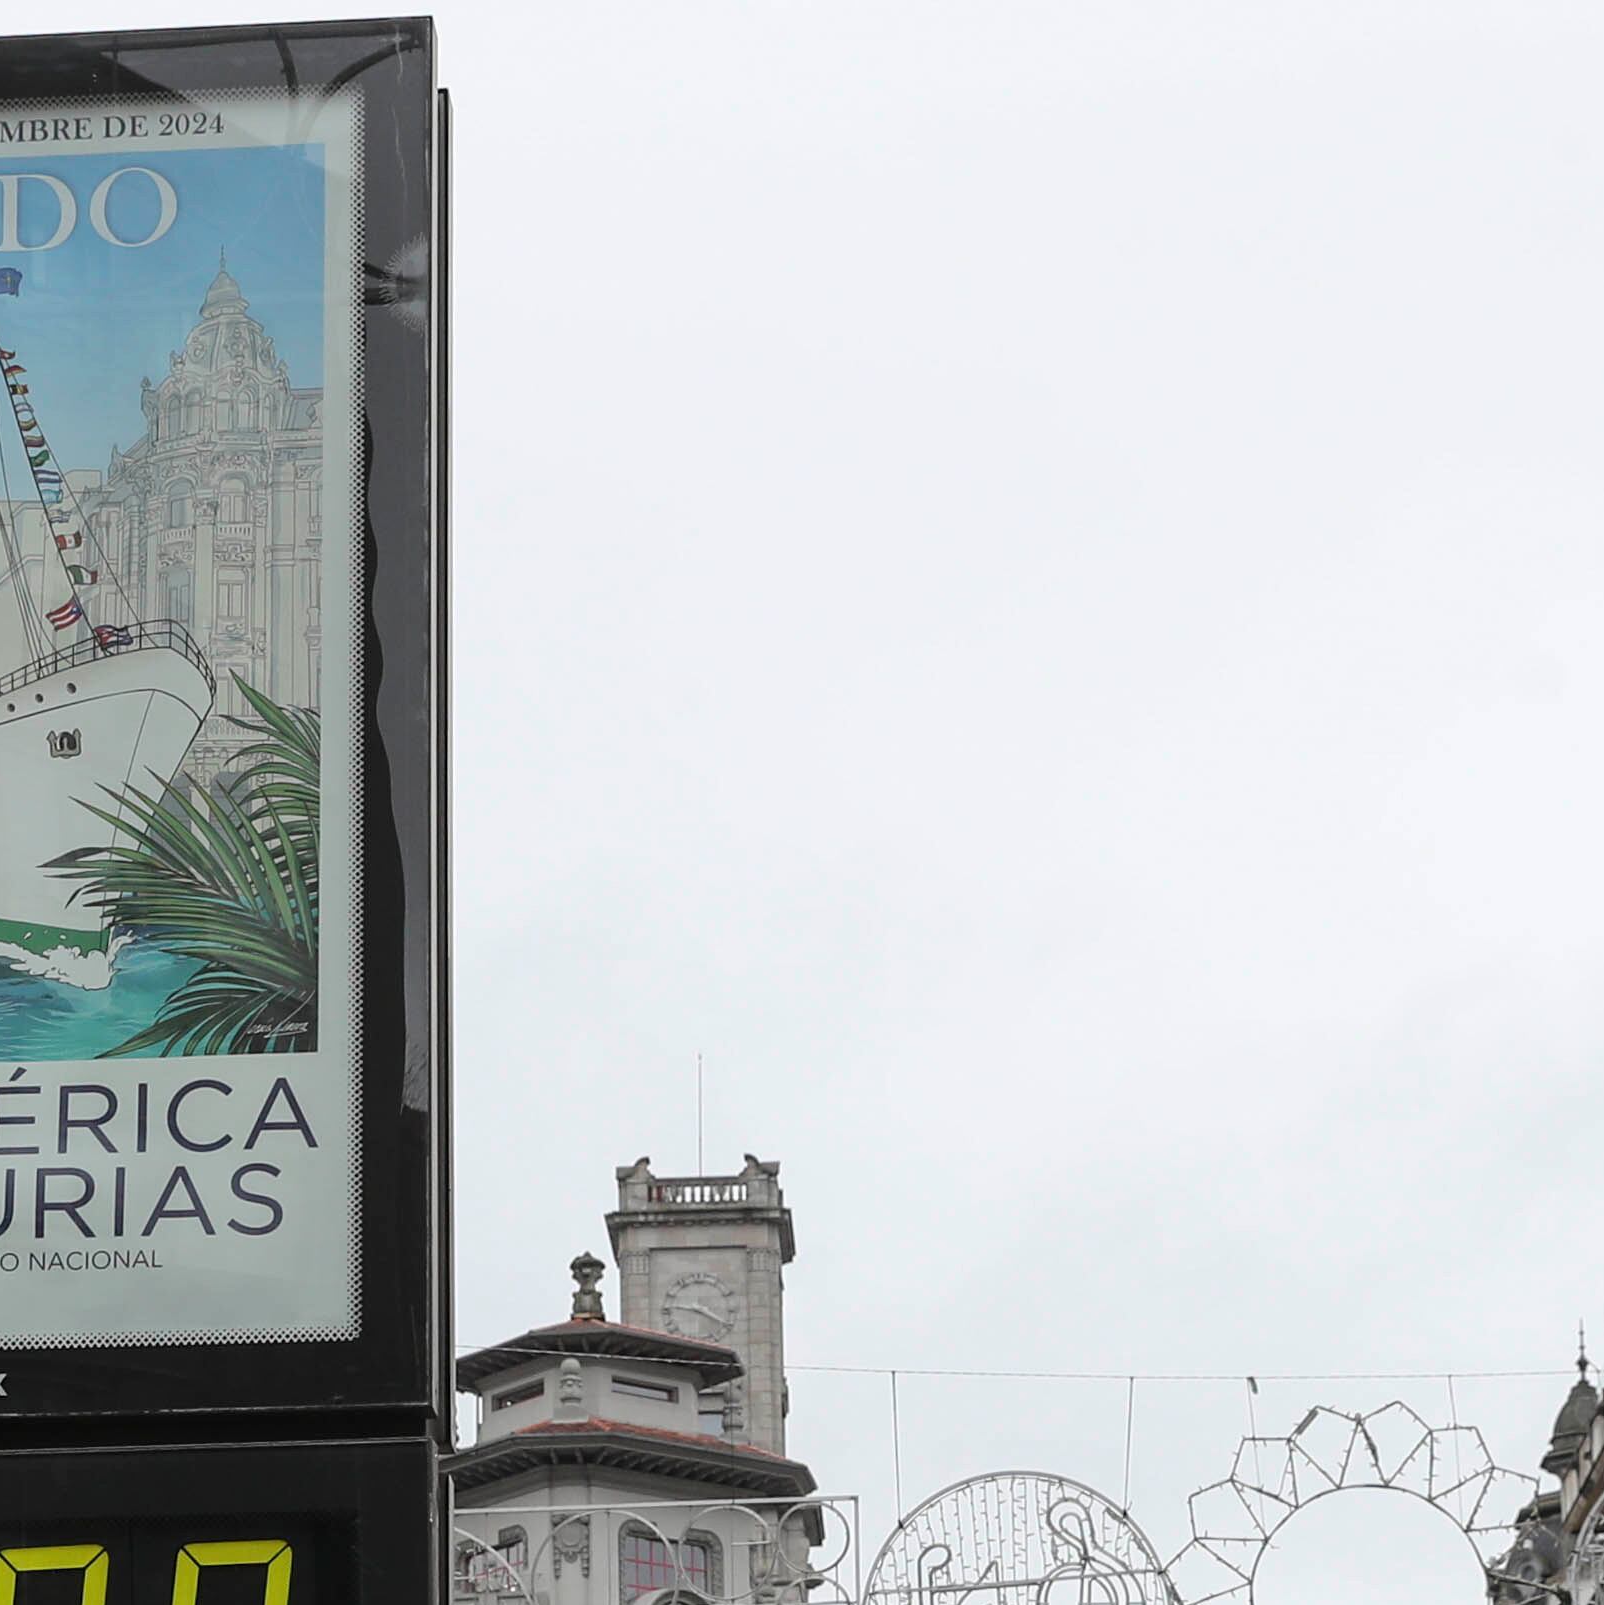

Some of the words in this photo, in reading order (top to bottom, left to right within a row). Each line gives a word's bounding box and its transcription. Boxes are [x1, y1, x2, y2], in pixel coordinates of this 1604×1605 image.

[103, 114, 149, 138] DE
[158, 111, 225, 136] 2024
[29, 1249, 164, 1271] NACIONAL
